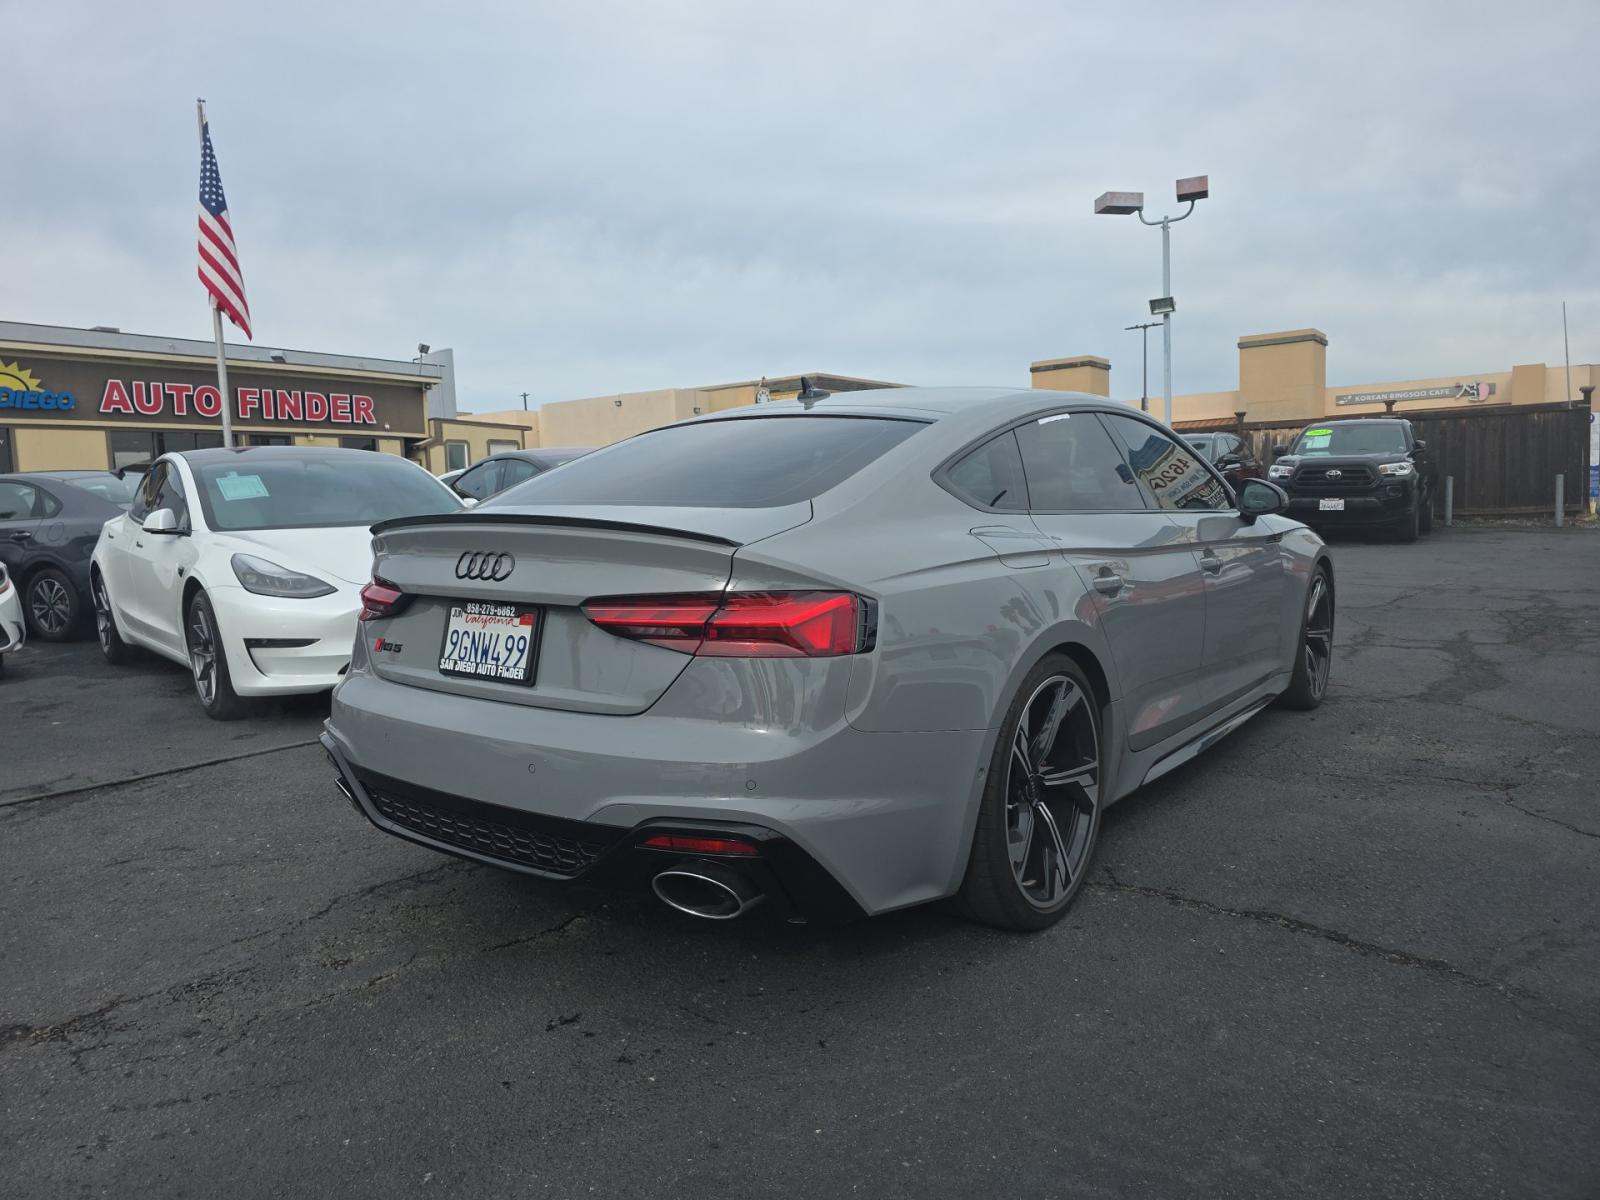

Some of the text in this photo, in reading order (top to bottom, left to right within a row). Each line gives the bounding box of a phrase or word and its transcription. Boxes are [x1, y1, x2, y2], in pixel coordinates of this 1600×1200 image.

[100, 379, 377, 424] AUTO FINDER
[1355, 394, 1387, 402] KOREAN
[447, 629, 527, 668] 9GNW499
[440, 658, 455, 670] SAN
[455, 660, 477, 674] DIEGO
[477, 663, 497, 677] AUTO
